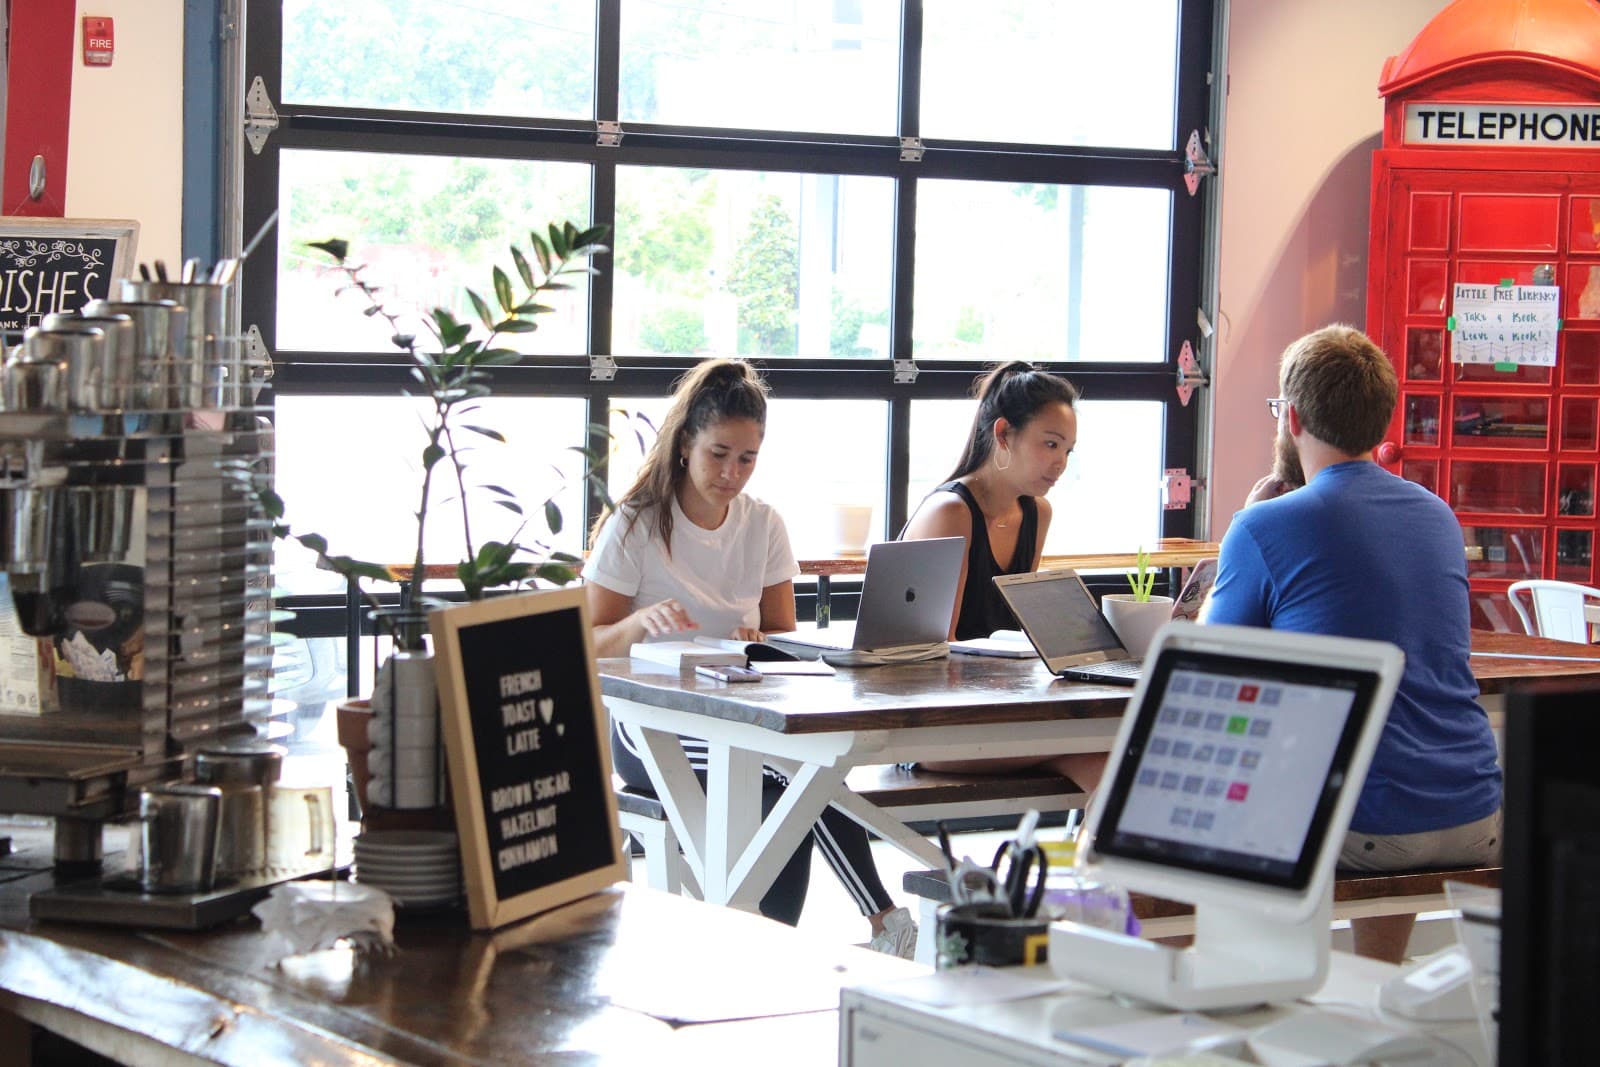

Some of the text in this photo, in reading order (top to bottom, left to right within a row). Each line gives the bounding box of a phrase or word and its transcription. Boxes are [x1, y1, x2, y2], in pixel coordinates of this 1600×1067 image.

[89, 38, 112, 49] FIRE
[1417, 111, 1600, 141] TELEPHONE
[0, 269, 99, 314] ISHES
[499, 669, 542, 698] FRENCH
[501, 699, 536, 727] TOAST
[506, 727, 541, 756] LATTE
[491, 771, 571, 813] BROWN SUGAR
[501, 804, 557, 840] HAZELNUT
[498, 833, 558, 871] CINNAMON
